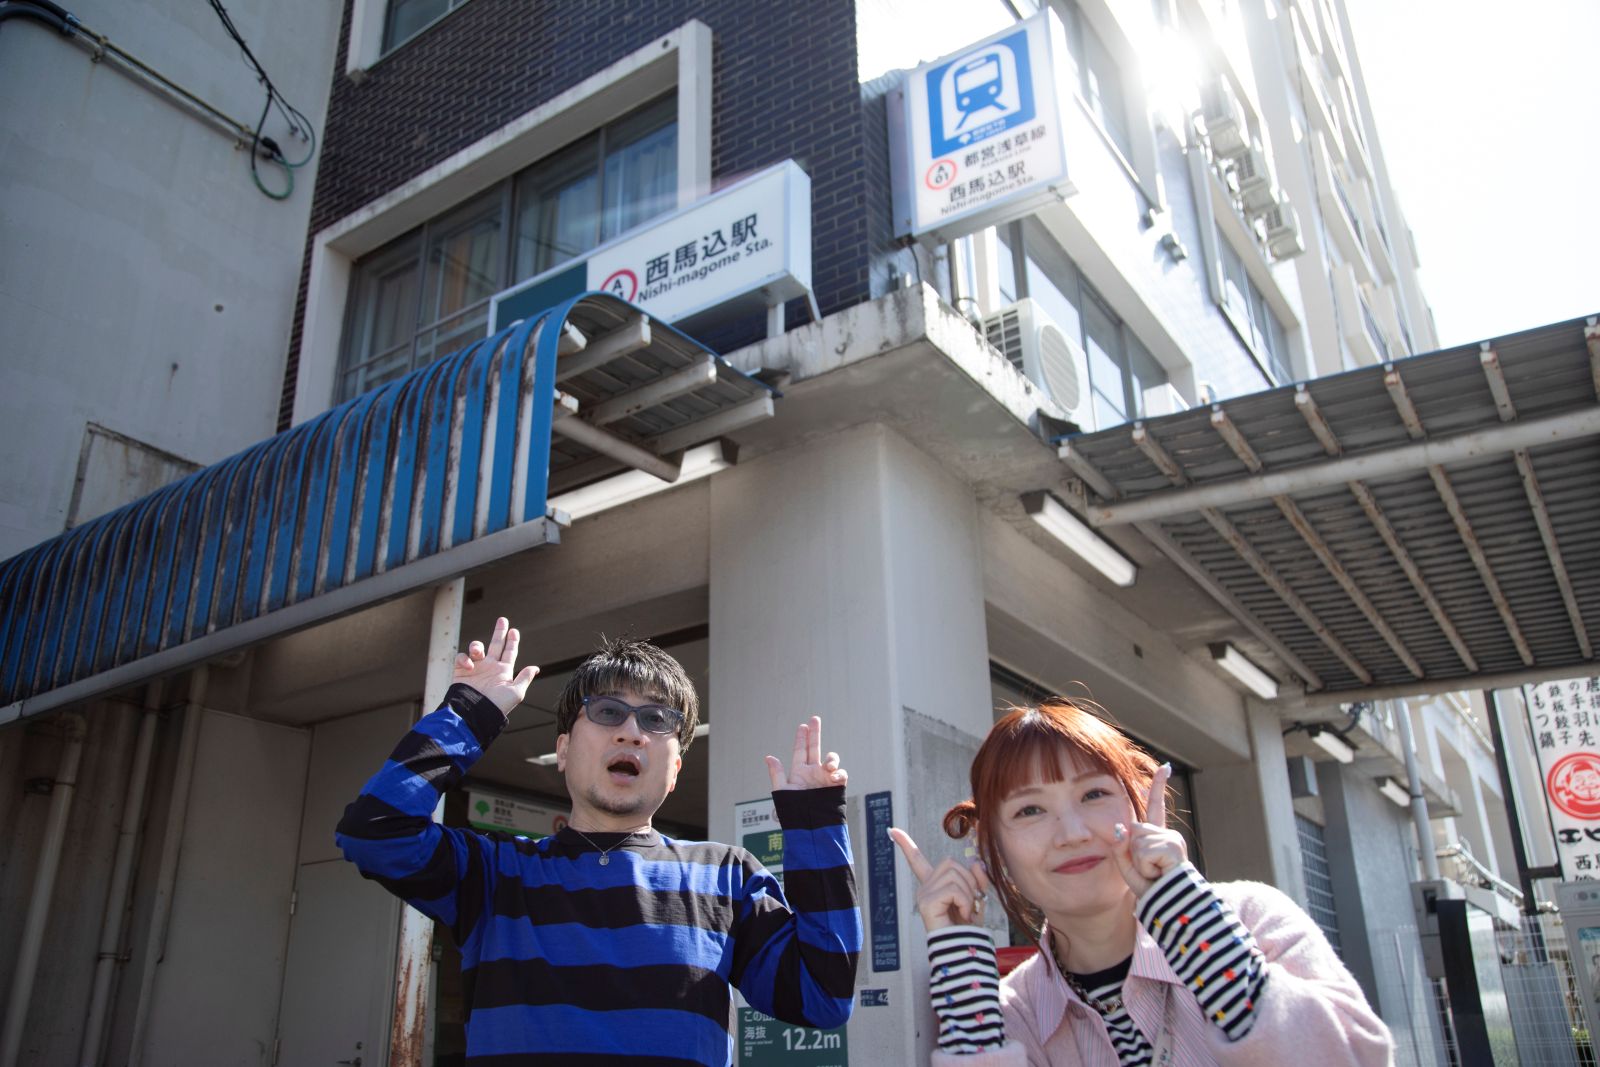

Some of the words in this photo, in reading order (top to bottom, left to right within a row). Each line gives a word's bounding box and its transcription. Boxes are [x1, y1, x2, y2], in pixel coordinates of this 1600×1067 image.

[964, 125, 1046, 167] 都営浅草線
[935, 172, 949, 184] 01
[937, 164, 944, 173] A
[950, 160, 1025, 202] 西馬込駅
[941, 181, 1016, 215] Nishi-magome
[646, 213, 758, 286] 西馬込駅
[638, 250, 740, 303] Nishi-magome
[745, 238, 773, 257] Sta.
[612, 279, 623, 292] A
[1569, 681, 1596, 746] の手羽先
[768, 833, 783, 852] 南
[744, 1025, 766, 1040] 海抜
[782, 1027, 841, 1051] 12.2m
